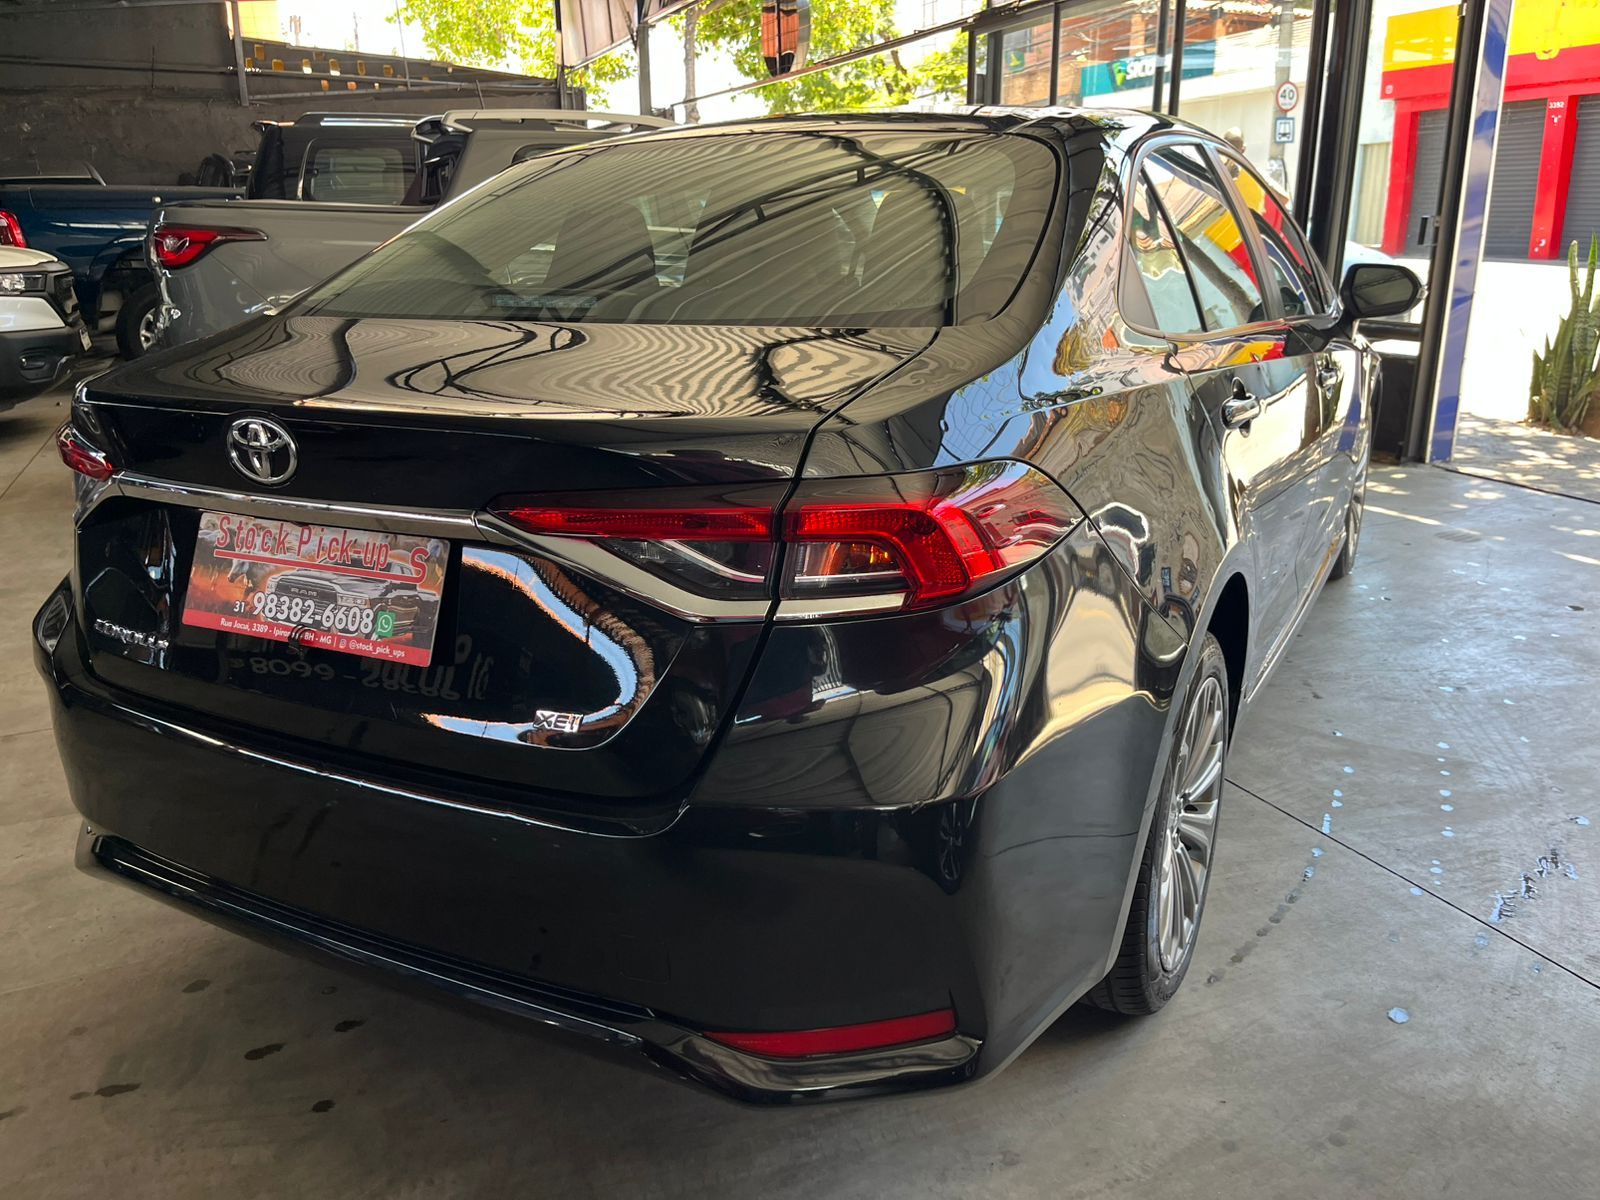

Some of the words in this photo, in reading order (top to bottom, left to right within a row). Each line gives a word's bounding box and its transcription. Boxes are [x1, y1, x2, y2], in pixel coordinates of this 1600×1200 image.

[1280, 89, 1295, 100] 40
[215, 515, 288, 556] Stock
[296, 524, 390, 573] Pick-up
[290, 587, 319, 597] RAM
[233, 600, 245, 613] 31
[253, 592, 374, 634] 98382-6608
[220, 617, 233, 627] Rua
[252, 623, 268, 633] 3389
[304, 632, 315, 641] BH
[320, 636, 332, 645] MG
[349, 639, 405, 657] @stock_pick_ups
